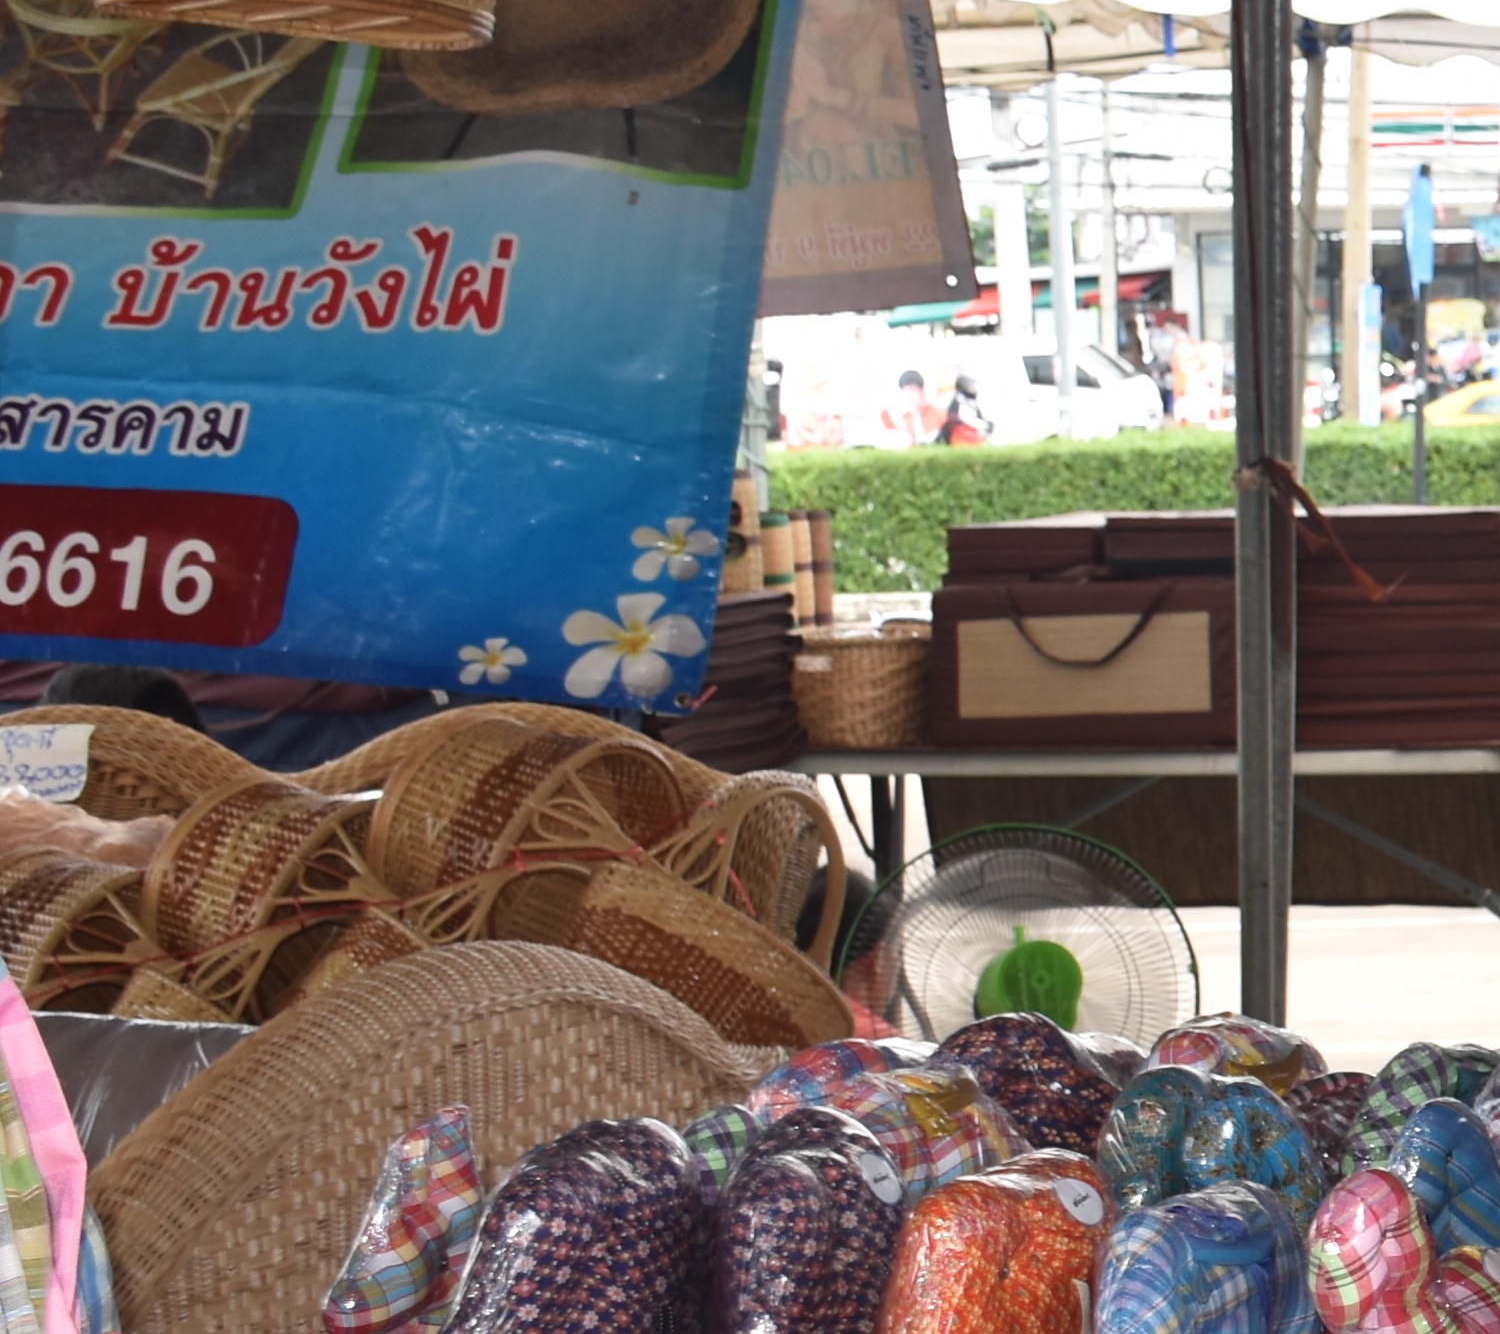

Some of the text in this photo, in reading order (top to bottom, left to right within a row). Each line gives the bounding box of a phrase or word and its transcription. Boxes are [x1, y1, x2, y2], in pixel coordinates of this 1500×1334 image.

[108, 225, 514, 330] บ้านวังไผ่
[0, 531, 217, 616] 6616
